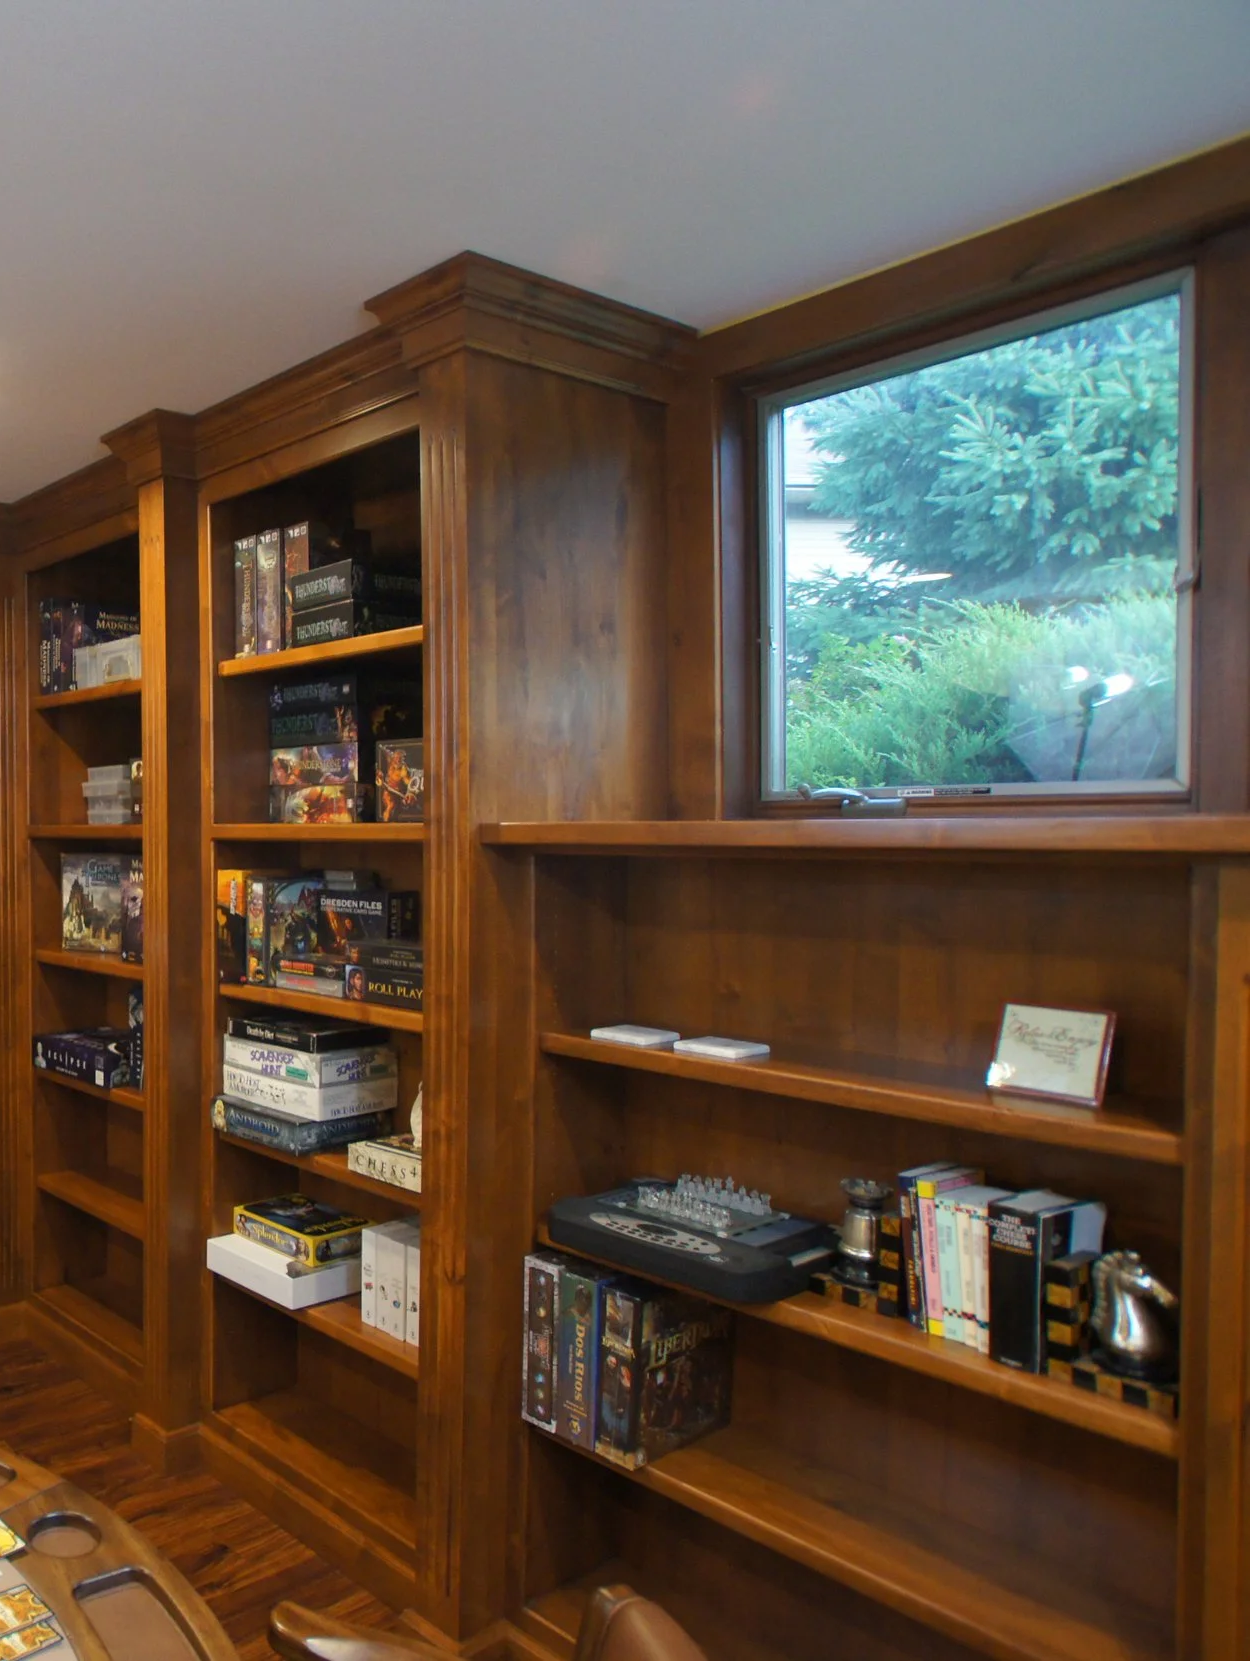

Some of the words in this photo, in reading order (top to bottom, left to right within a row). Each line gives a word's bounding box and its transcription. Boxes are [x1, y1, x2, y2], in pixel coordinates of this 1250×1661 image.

[320, 898, 358, 909] DRESDEN
[358, 900, 383, 911] FILES
[368, 982, 394, 996] ROLL
[397, 985, 423, 999] PLAY
[47, 1049, 87, 1070] ECLIPSE
[250, 1050, 295, 1065] SCAVENGER
[261, 1064, 282, 1076] HUNT
[226, 1109, 280, 1134] ANDROID
[356, 1154, 407, 1180] CHESS
[1001, 1213, 1022, 1225] THE
[252, 1223, 288, 1245] Splendor
[575, 1323, 586, 1358] DOS
[574, 1360, 586, 1402] RIOS
